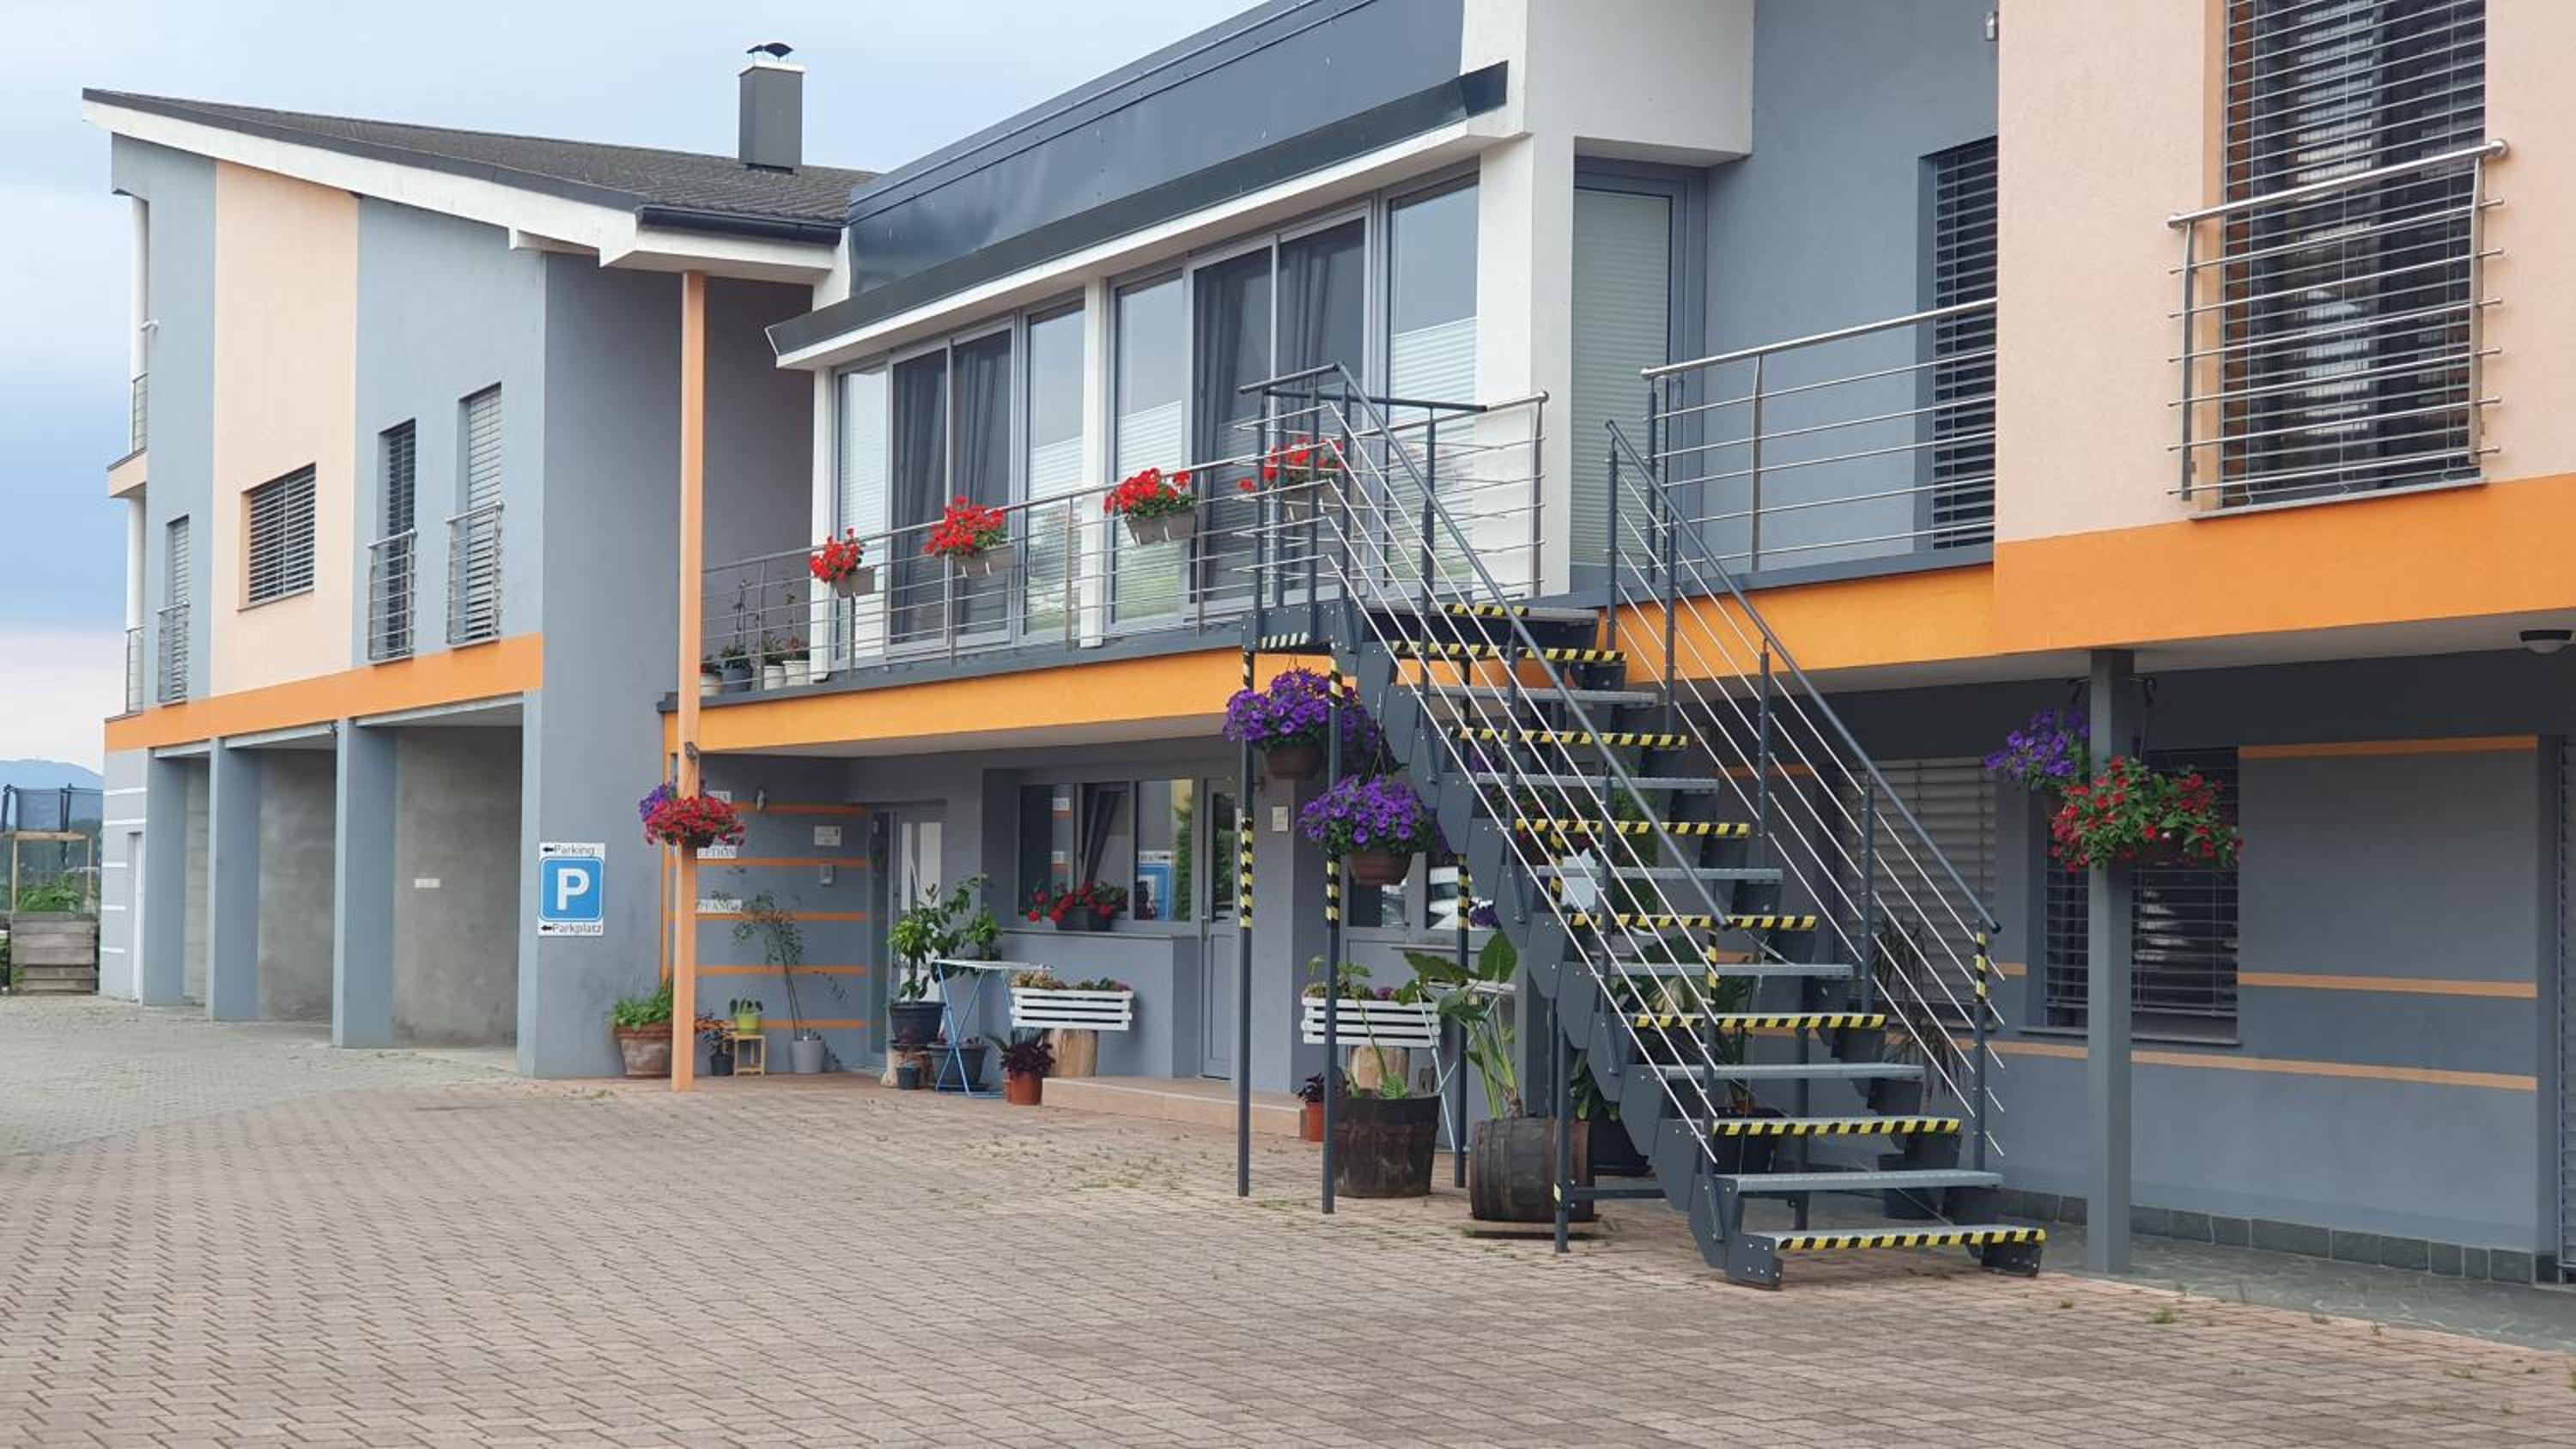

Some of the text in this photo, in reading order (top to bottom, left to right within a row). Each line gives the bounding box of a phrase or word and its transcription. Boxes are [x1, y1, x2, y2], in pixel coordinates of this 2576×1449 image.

[555, 844, 595, 858] Parking
[556, 868, 590, 911] P
[552, 923, 601, 936] Parkplatz
